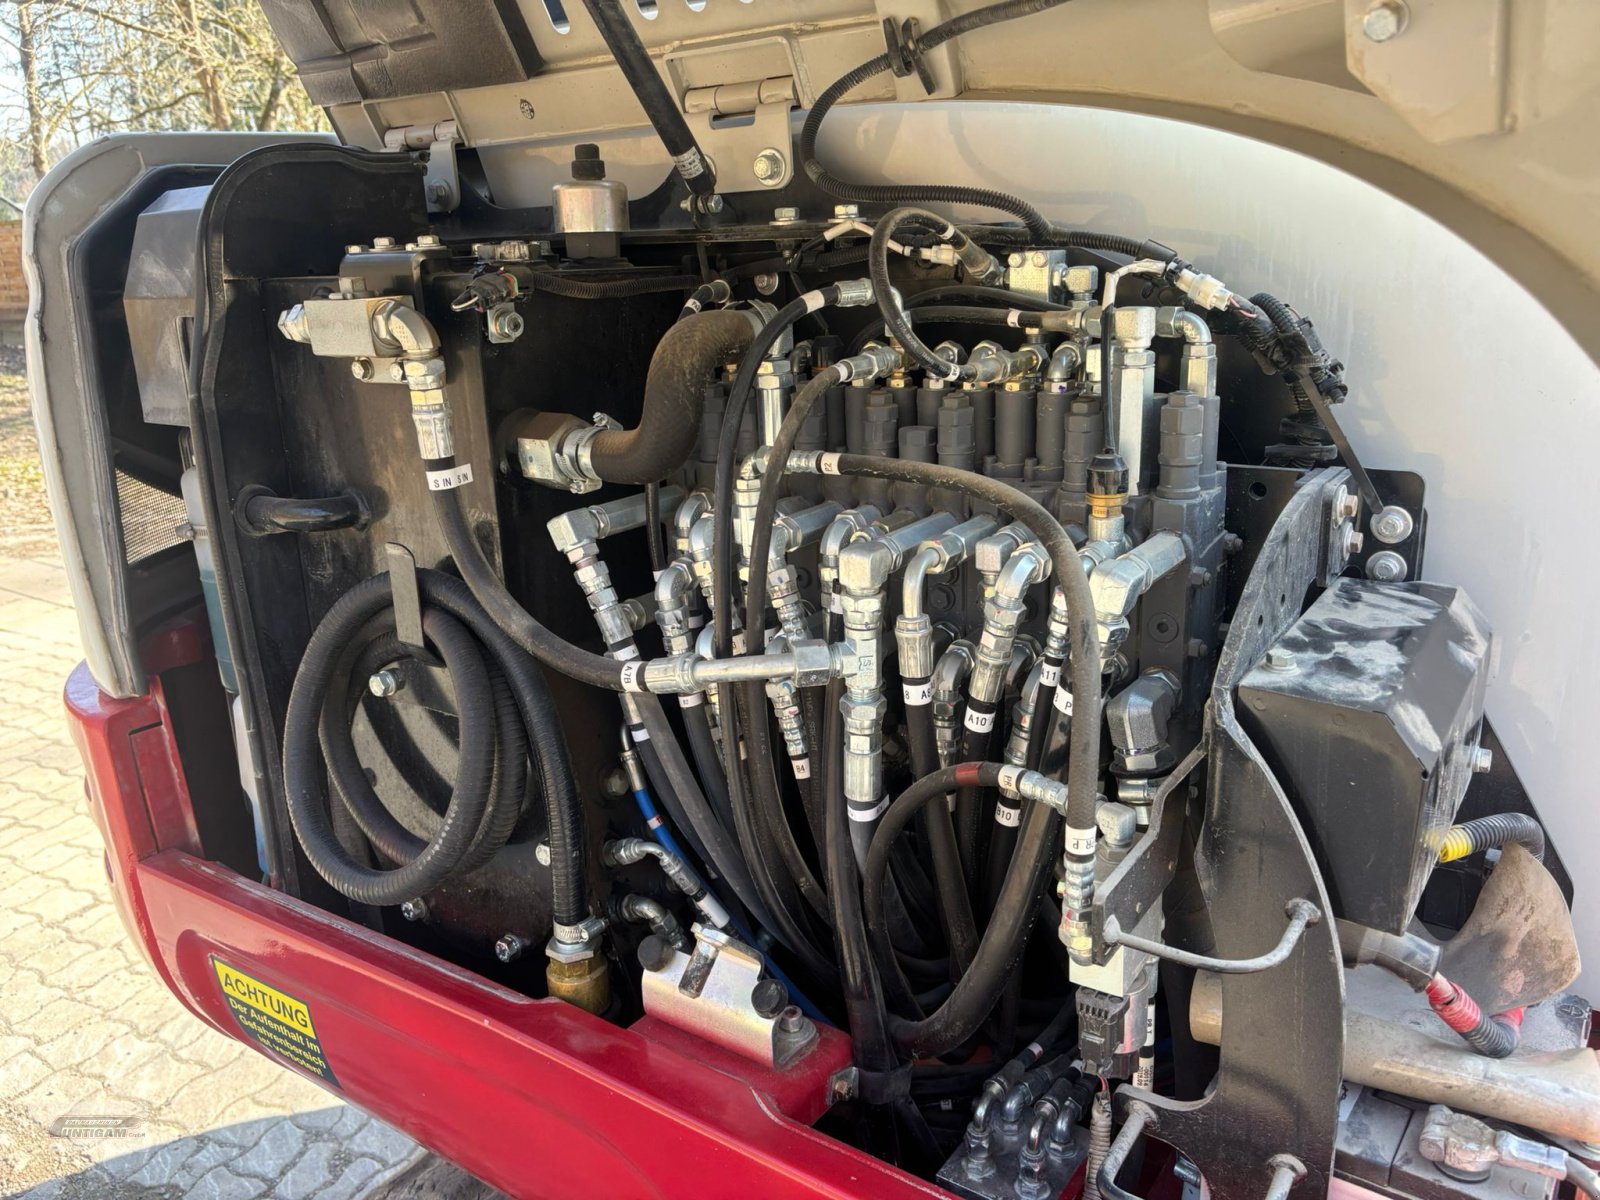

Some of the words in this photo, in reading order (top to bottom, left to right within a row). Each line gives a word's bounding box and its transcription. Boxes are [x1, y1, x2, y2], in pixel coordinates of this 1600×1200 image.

[433, 479, 440, 488] S
[442, 477, 452, 488] IN
[462, 472, 469, 482] IN
[968, 714, 987, 726] A10
[795, 764, 806, 773] B4
[223, 972, 309, 1028] ACHTUNG
[229, 998, 248, 1014] Der
[250, 1009, 305, 1046] Aufenthalt
[305, 1038, 321, 1054] im
[238, 1014, 327, 1069] Gefahrenbereich
